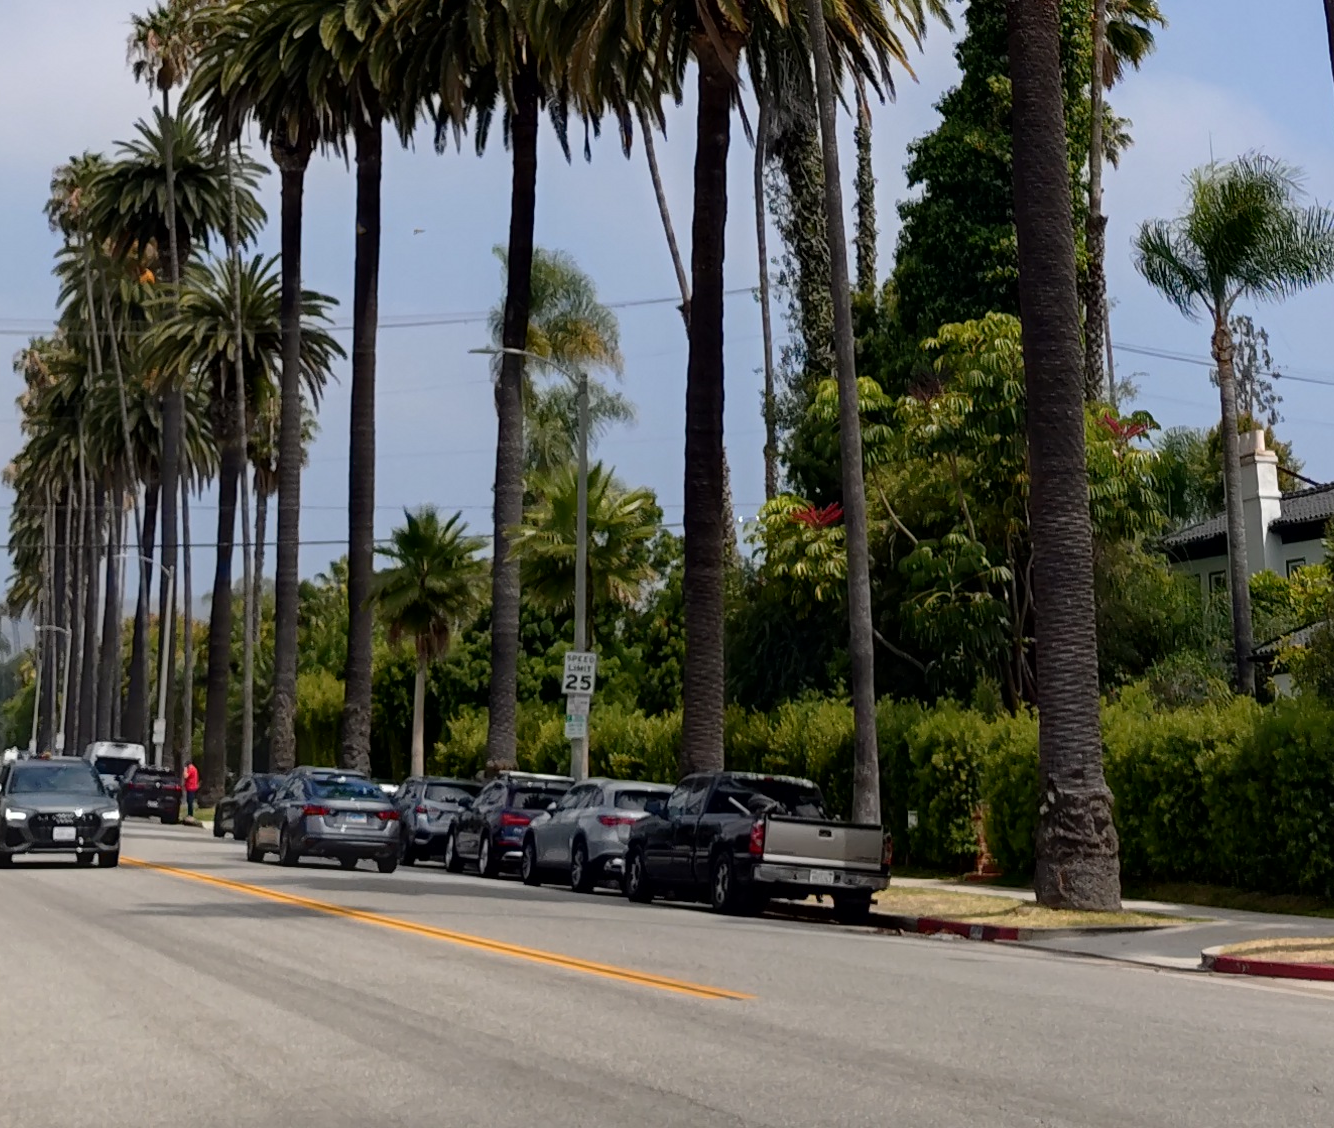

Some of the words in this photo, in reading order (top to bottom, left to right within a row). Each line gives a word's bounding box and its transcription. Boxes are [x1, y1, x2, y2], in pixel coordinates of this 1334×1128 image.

[567, 655, 595, 663] SPEED
[568, 664, 592, 672] LIMIT
[565, 674, 592, 690] 25
